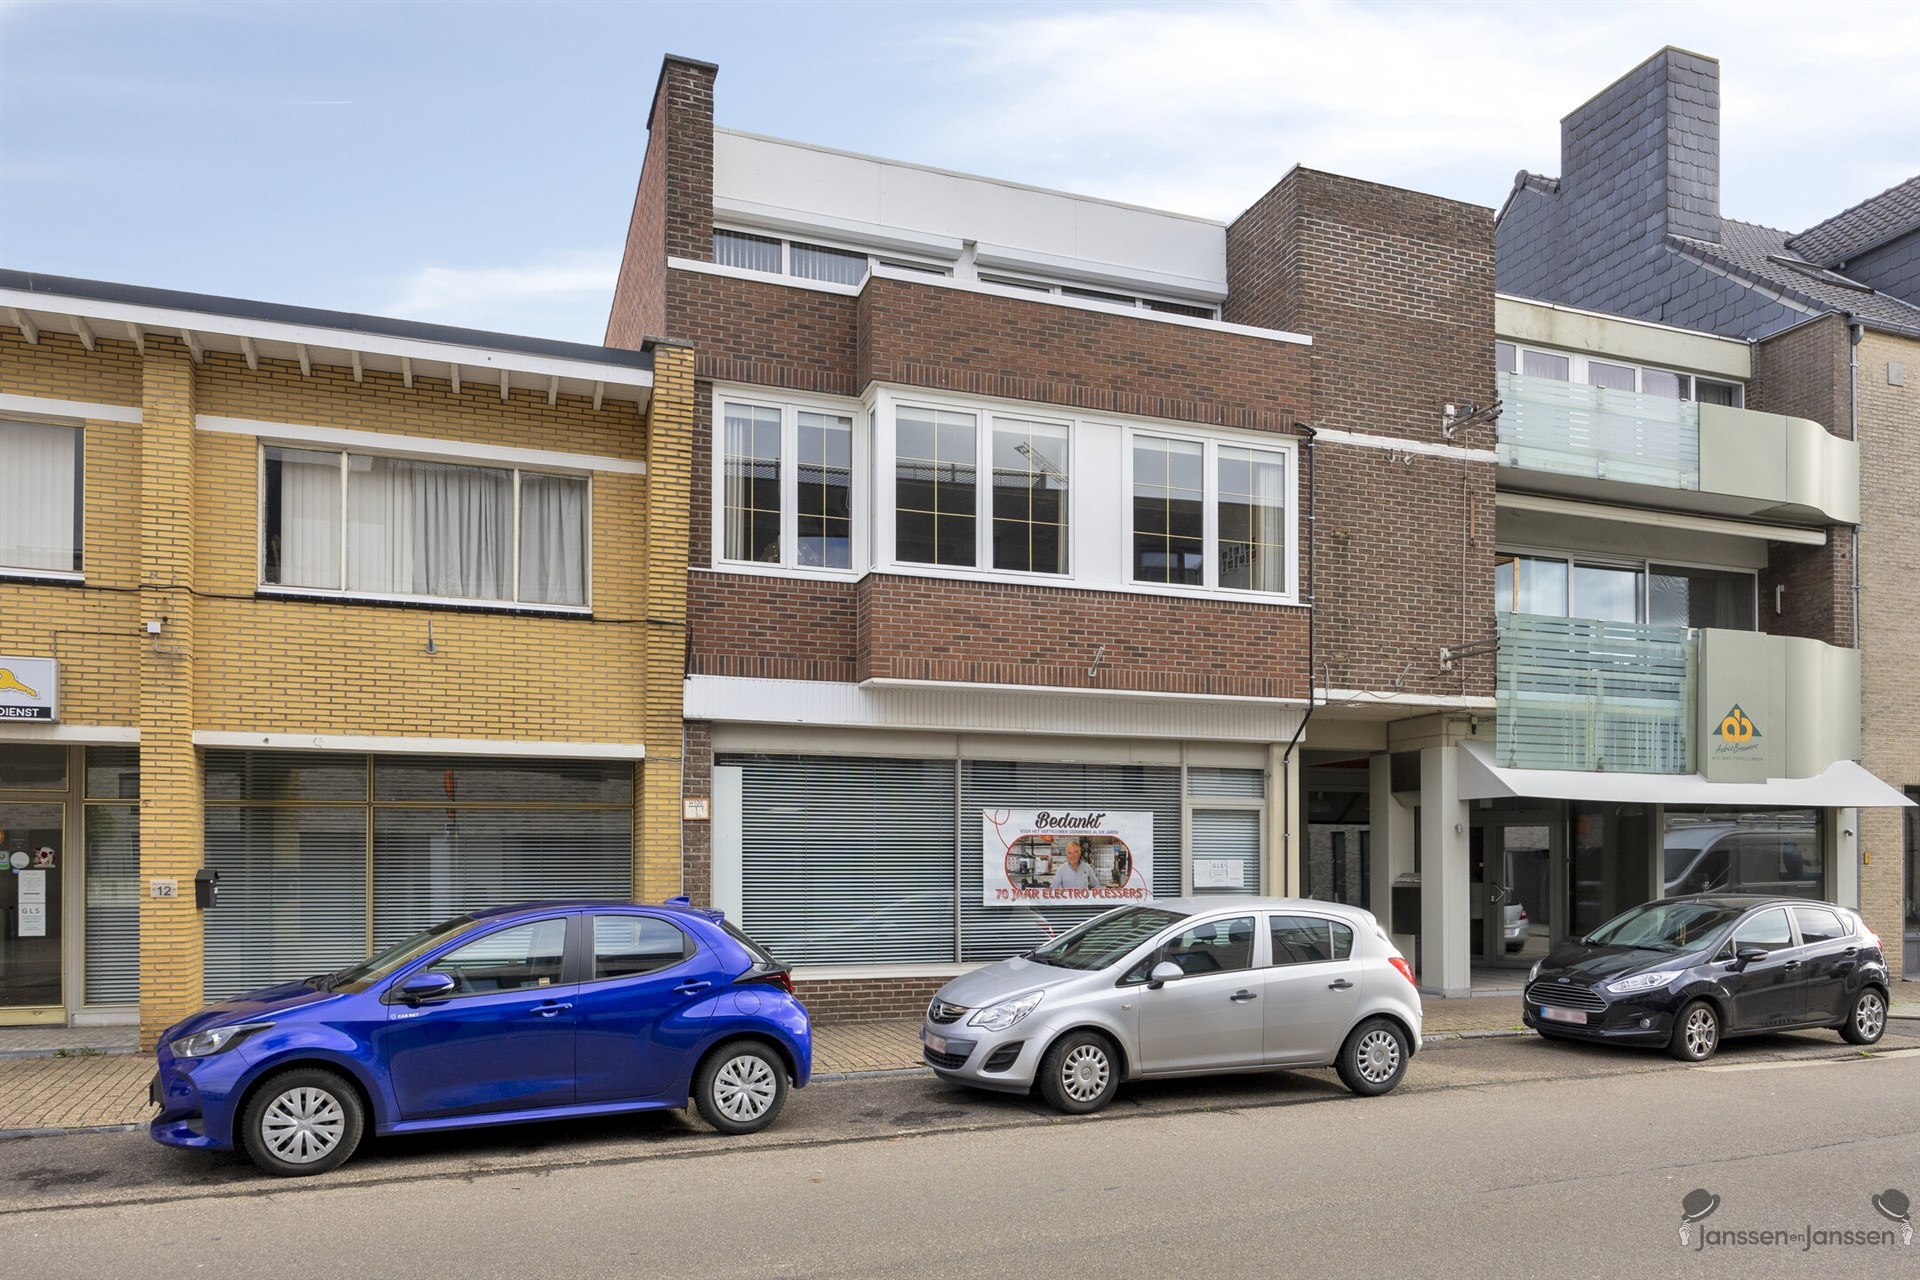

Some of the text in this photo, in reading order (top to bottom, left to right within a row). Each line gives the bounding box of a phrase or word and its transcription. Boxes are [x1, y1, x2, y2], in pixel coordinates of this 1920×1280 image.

[1035, 811, 1106, 829] Bedankt
[157, 885, 172, 896] 12
[995, 888, 1144, 901] 70 JAAR ELECTRO PLESSERS
